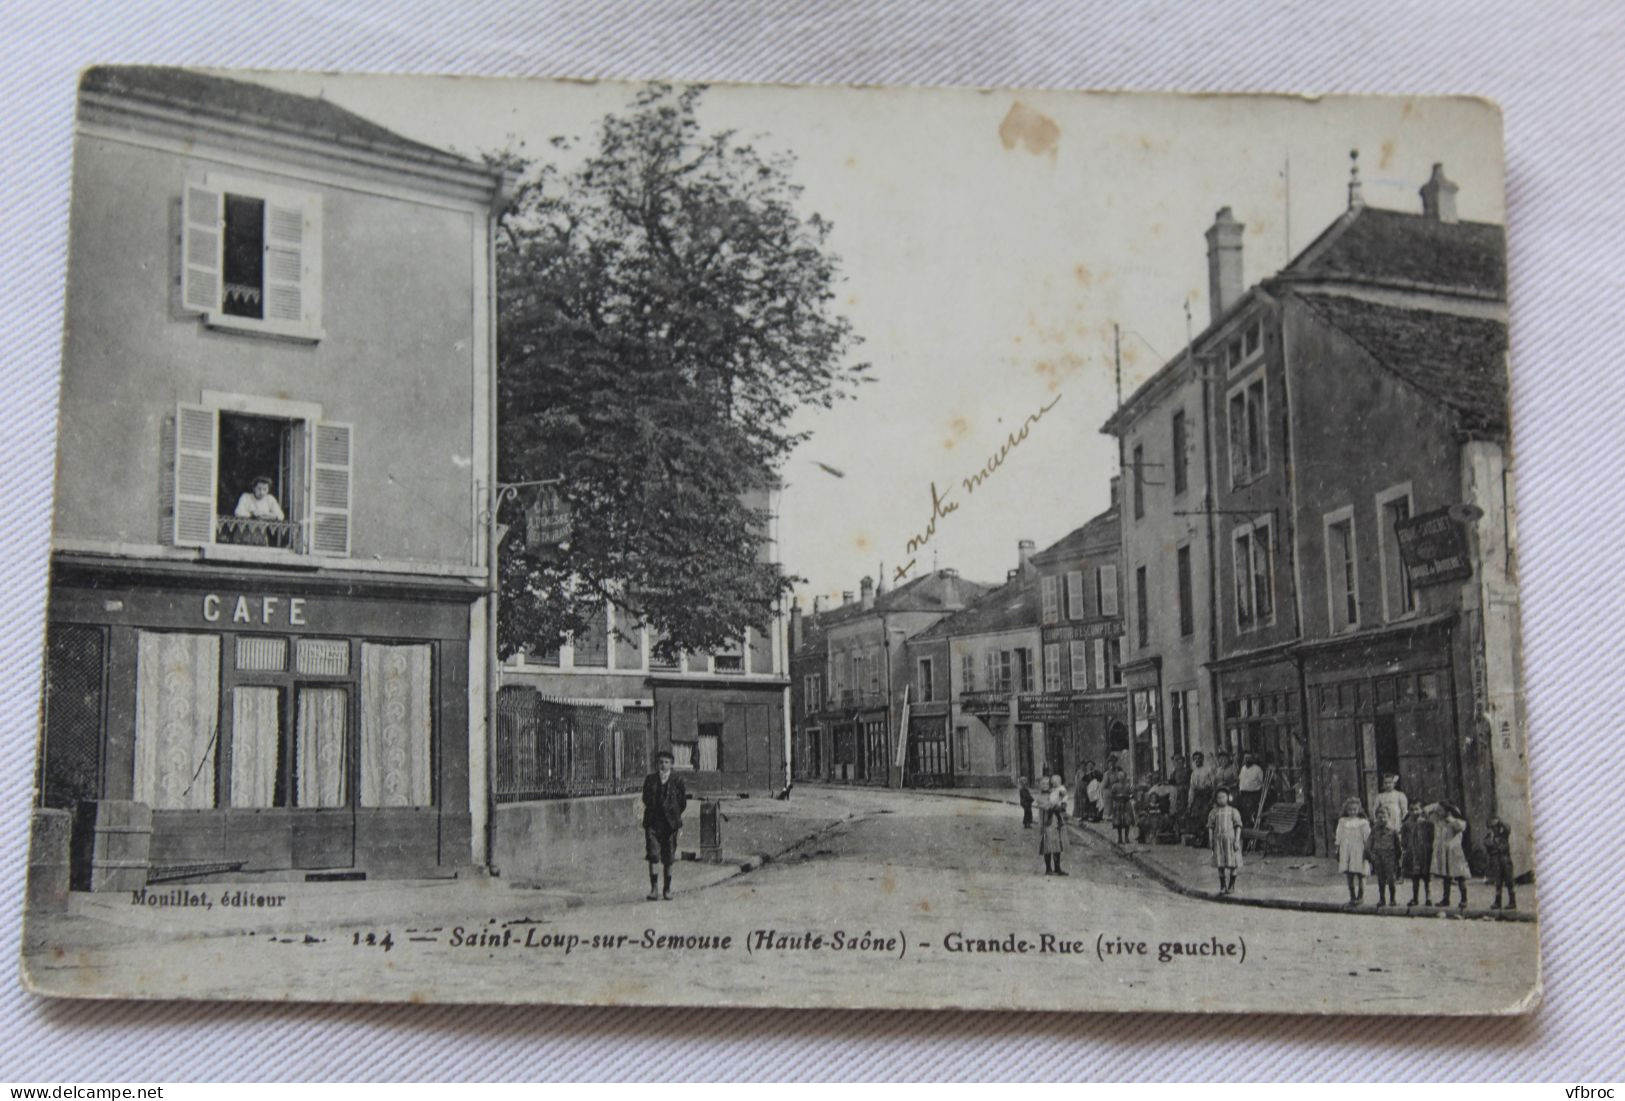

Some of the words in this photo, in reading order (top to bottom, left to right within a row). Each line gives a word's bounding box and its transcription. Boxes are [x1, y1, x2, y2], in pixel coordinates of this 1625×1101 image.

[963, 393, 1062, 493] maison
[203, 593, 307, 625] CAFE
[131, 889, 213, 911] Mouillet,
[220, 890, 286, 908] éditeur
[449, 926, 732, 955] Saint-Loup-sur-Semouse
[746, 930, 906, 960] (Haute-Saône)
[943, 932, 1085, 954] Grande-Rue
[1096, 933, 1147, 963] (rive
[1157, 936, 1247, 964] gauche)
